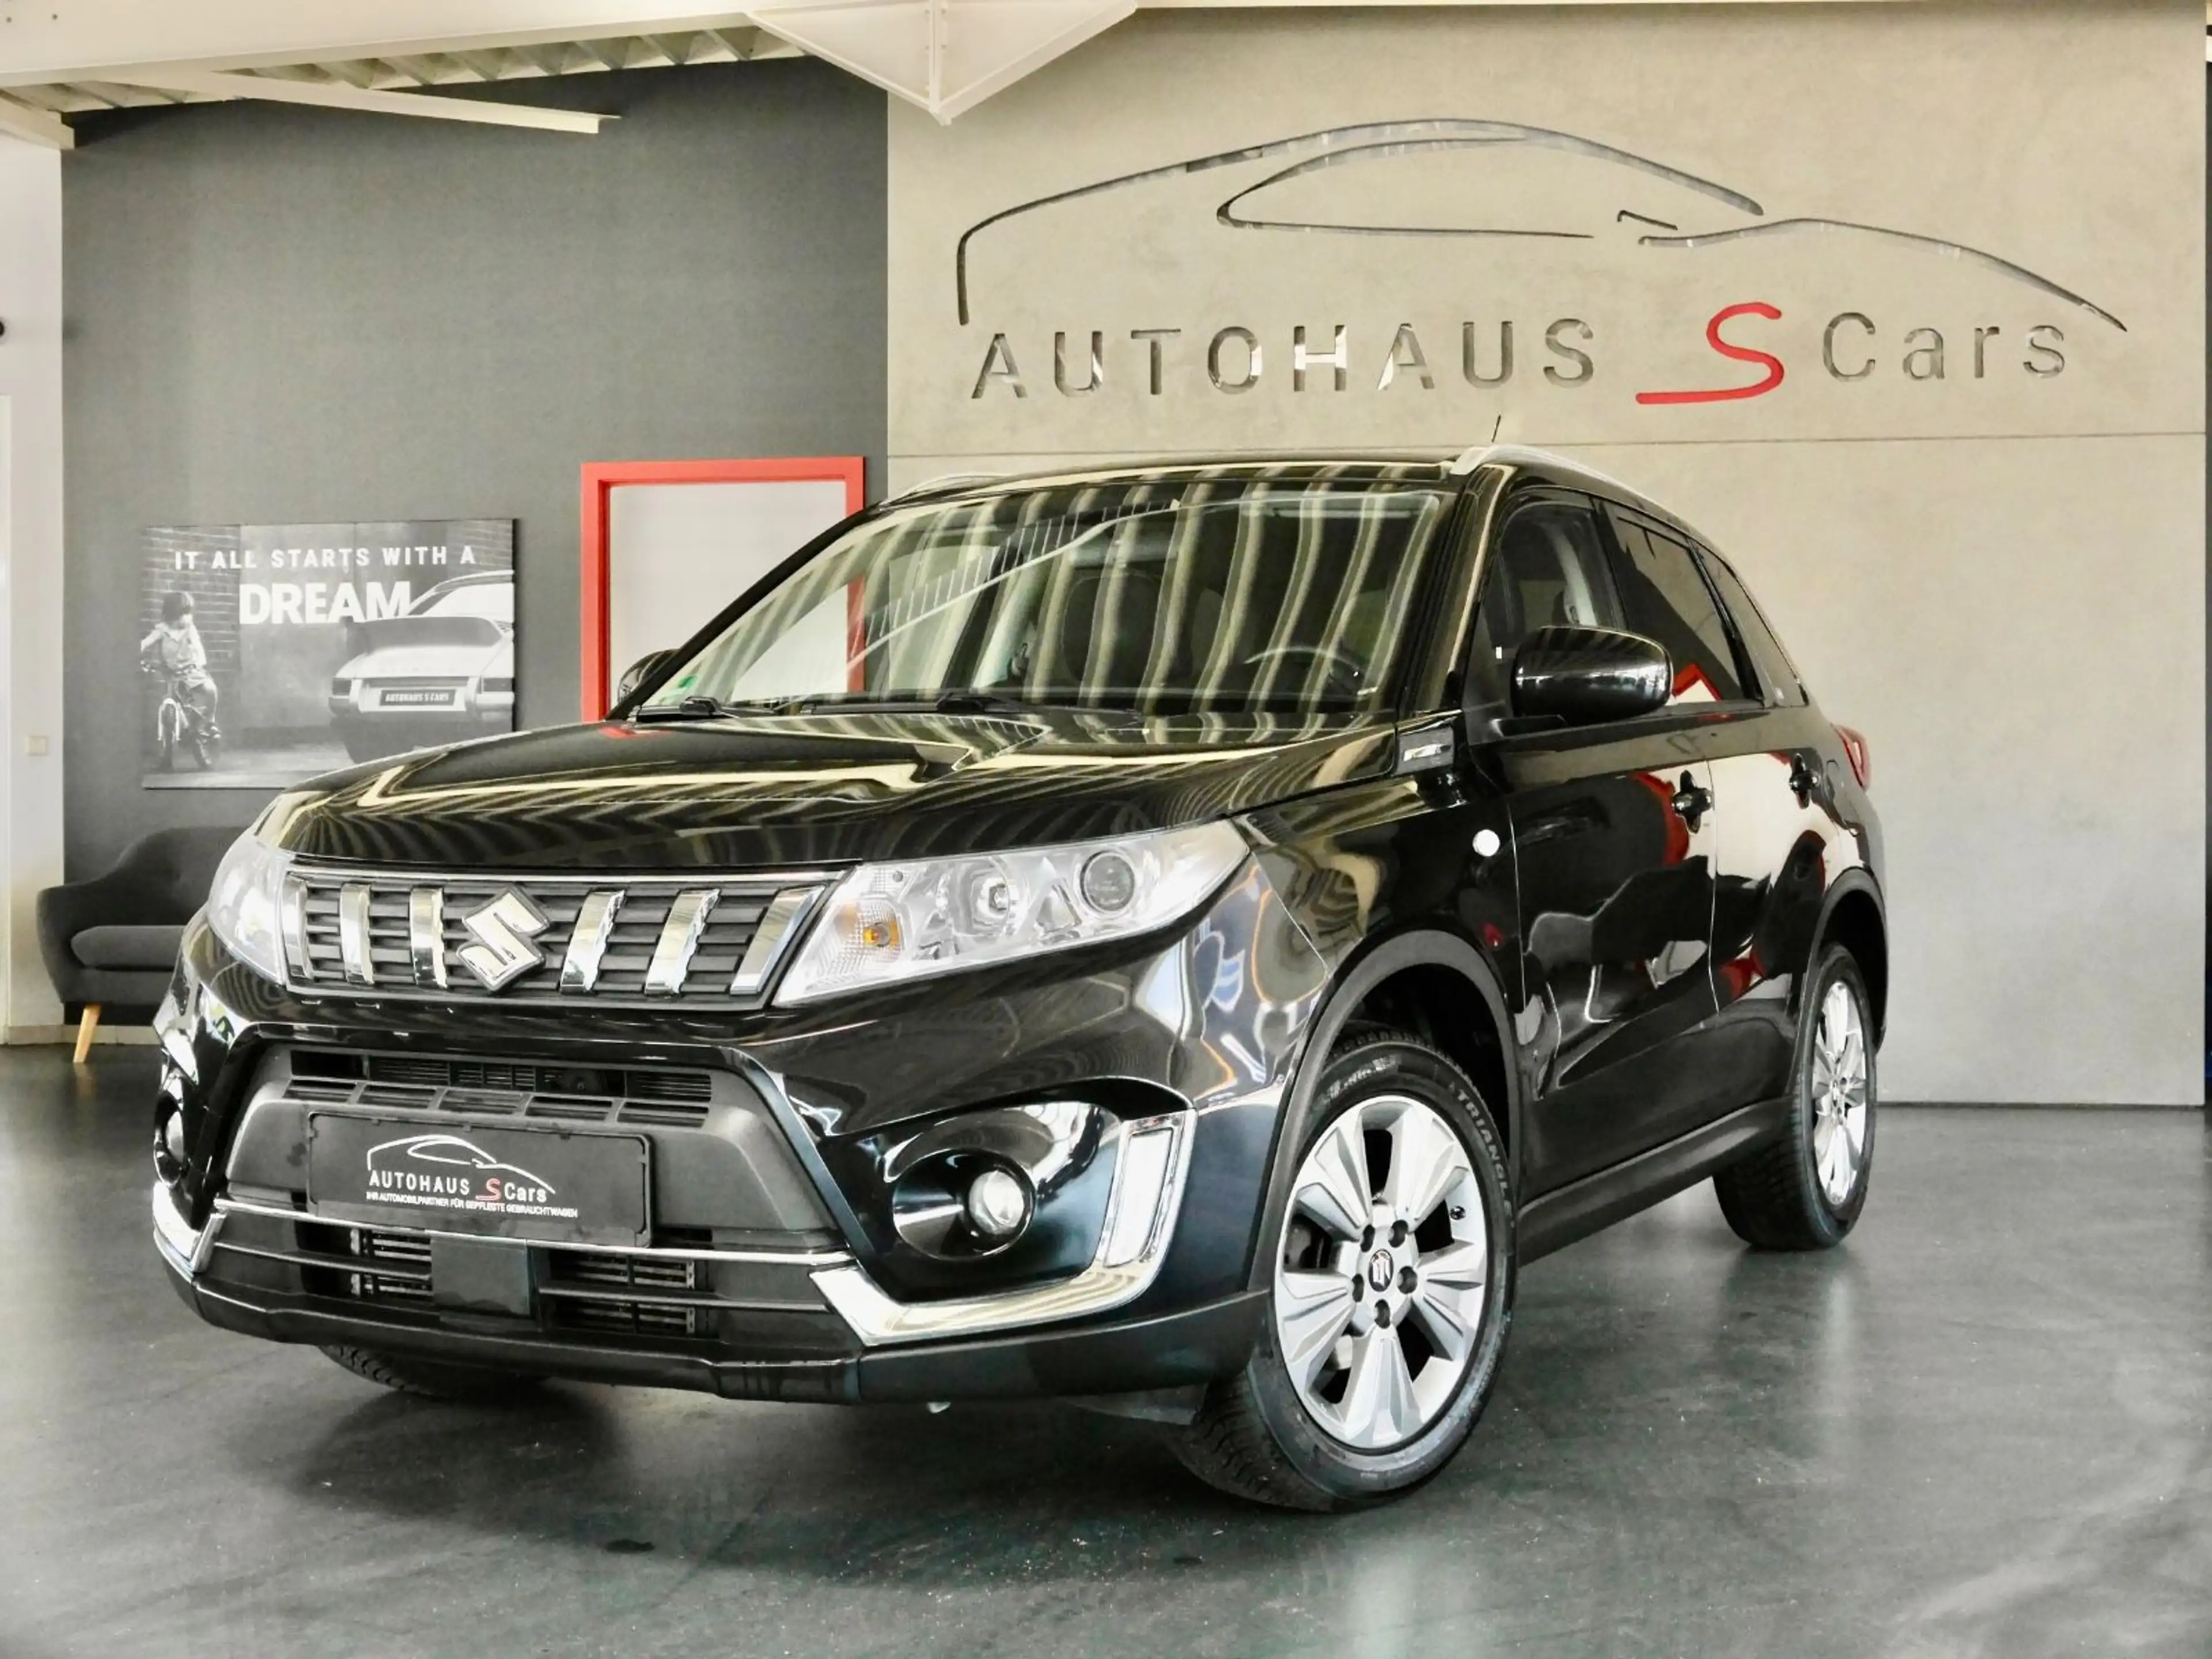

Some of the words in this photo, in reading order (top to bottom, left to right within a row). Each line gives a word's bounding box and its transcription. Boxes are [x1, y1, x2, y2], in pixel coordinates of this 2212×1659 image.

[971, 317, 1593, 399] AUTOHAUS
[1635, 301, 1785, 405] S
[1822, 312, 2066, 382] Cars
[175, 551, 199, 570] IT
[211, 550, 257, 570] ALL
[271, 547, 370, 569] STARTS
[382, 545, 447, 567] WITH
[459, 544, 476, 565] A
[238, 581, 411, 625] DREAM
[368, 1169, 470, 1195] AUTOHAUS
[475, 1177, 501, 1200] S
[504, 1181, 547, 1203] Cars
